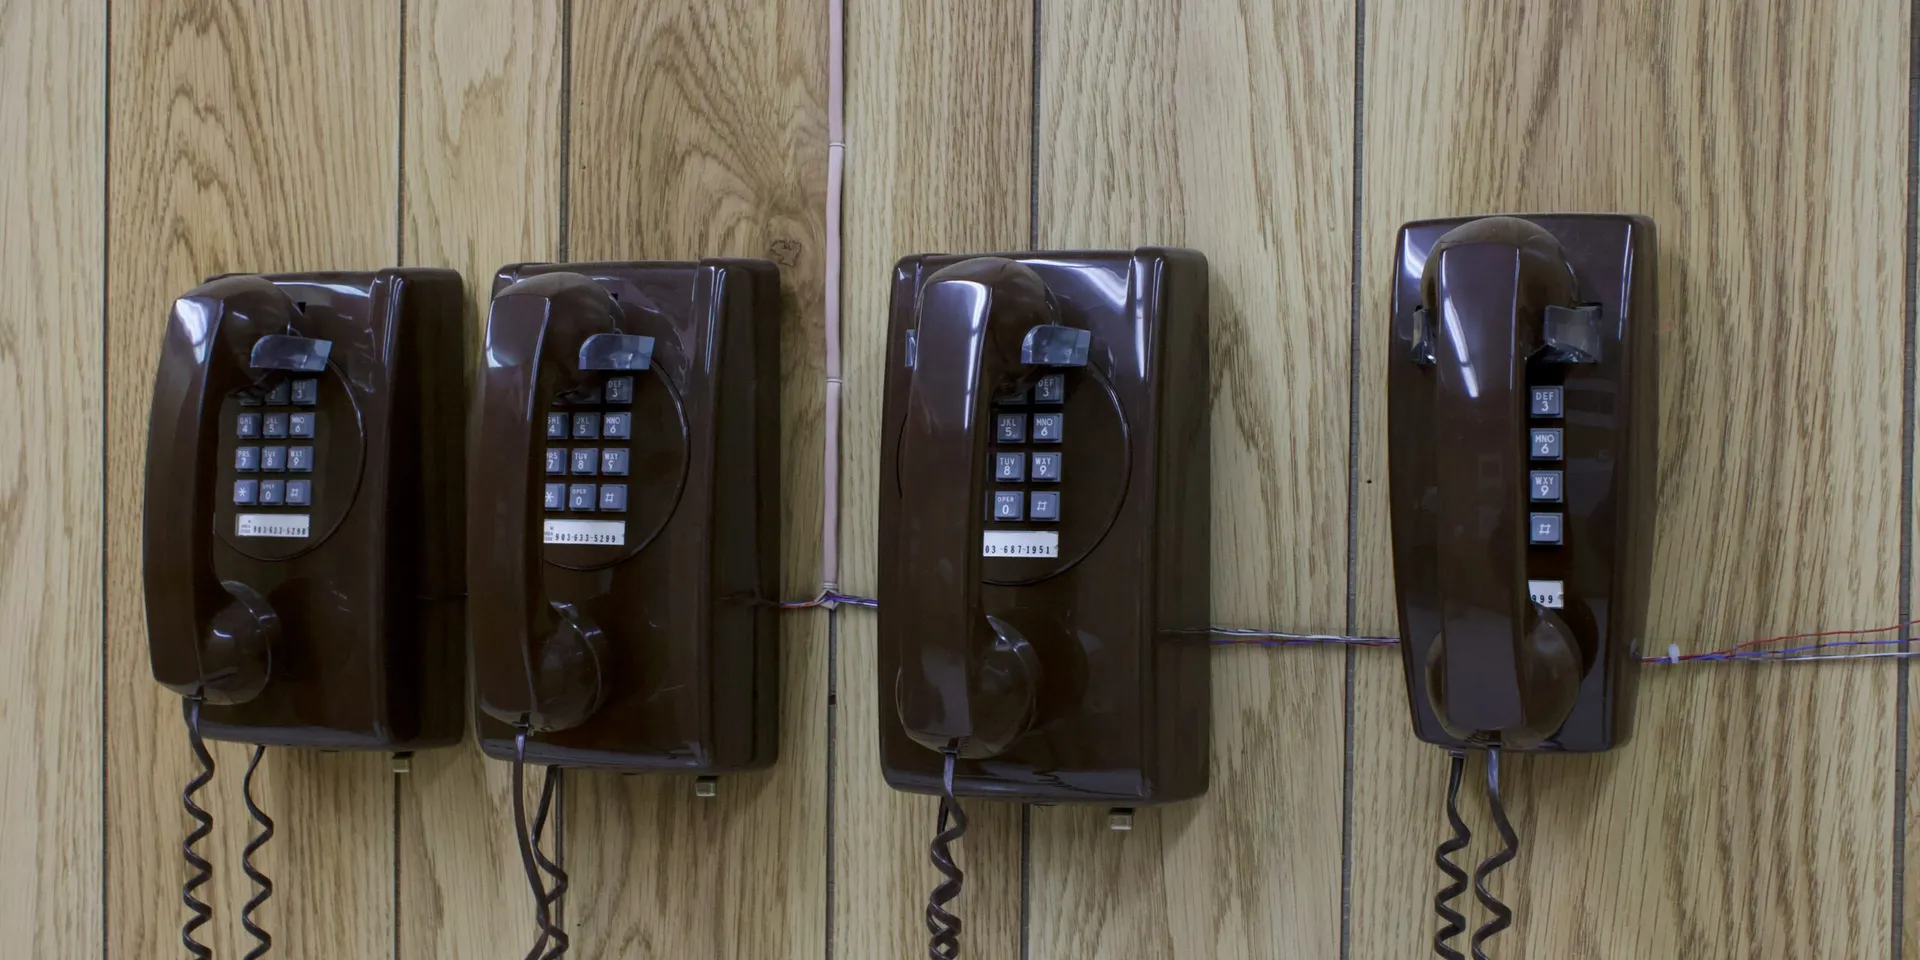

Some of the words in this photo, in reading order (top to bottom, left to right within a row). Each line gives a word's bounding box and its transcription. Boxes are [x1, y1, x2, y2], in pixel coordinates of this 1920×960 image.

[607, 380, 622, 389] DEF
[1038, 378, 1054, 388] DEF
[612, 388, 619, 398] 3
[1042, 387, 1050, 398] 3
[1535, 391, 1555, 401] DEF
[1541, 400, 1549, 412] 3
[291, 416, 305, 424] MNO
[575, 416, 590, 425] JKL
[606, 416, 621, 425] MNO
[1000, 418, 1017, 427] JKL
[1036, 418, 1053, 427] MNO
[242, 424, 248, 433] 4
[269, 424, 275, 433] 5
[295, 424, 301, 433] 6
[549, 425, 556, 434] 4
[579, 425, 586, 434] 5
[610, 425, 617, 434] 6
[1005, 427, 1012, 437] 5
[1040, 426, 1049, 436] 6
[1535, 434, 1555, 444] MNO
[1541, 443, 1550, 454] 6
[574, 452, 588, 460] TUV
[604, 452, 619, 460] WXY
[1034, 457, 1052, 465] WXY
[241, 457, 247, 467] 7
[267, 457, 273, 467] 8
[293, 457, 300, 467] 9
[548, 460, 554, 470] 7
[577, 460, 585, 470] 8
[607, 460, 615, 470] 9
[1000, 457, 1015, 466] TUV
[1003, 465, 1011, 476] 8
[1039, 465, 1047, 476] 9
[1535, 476, 1554, 485] WXY
[265, 490, 272, 500] 0
[1540, 484, 1549, 496] 9
[575, 496, 583, 506] 0
[1002, 504, 1010, 515] 0
